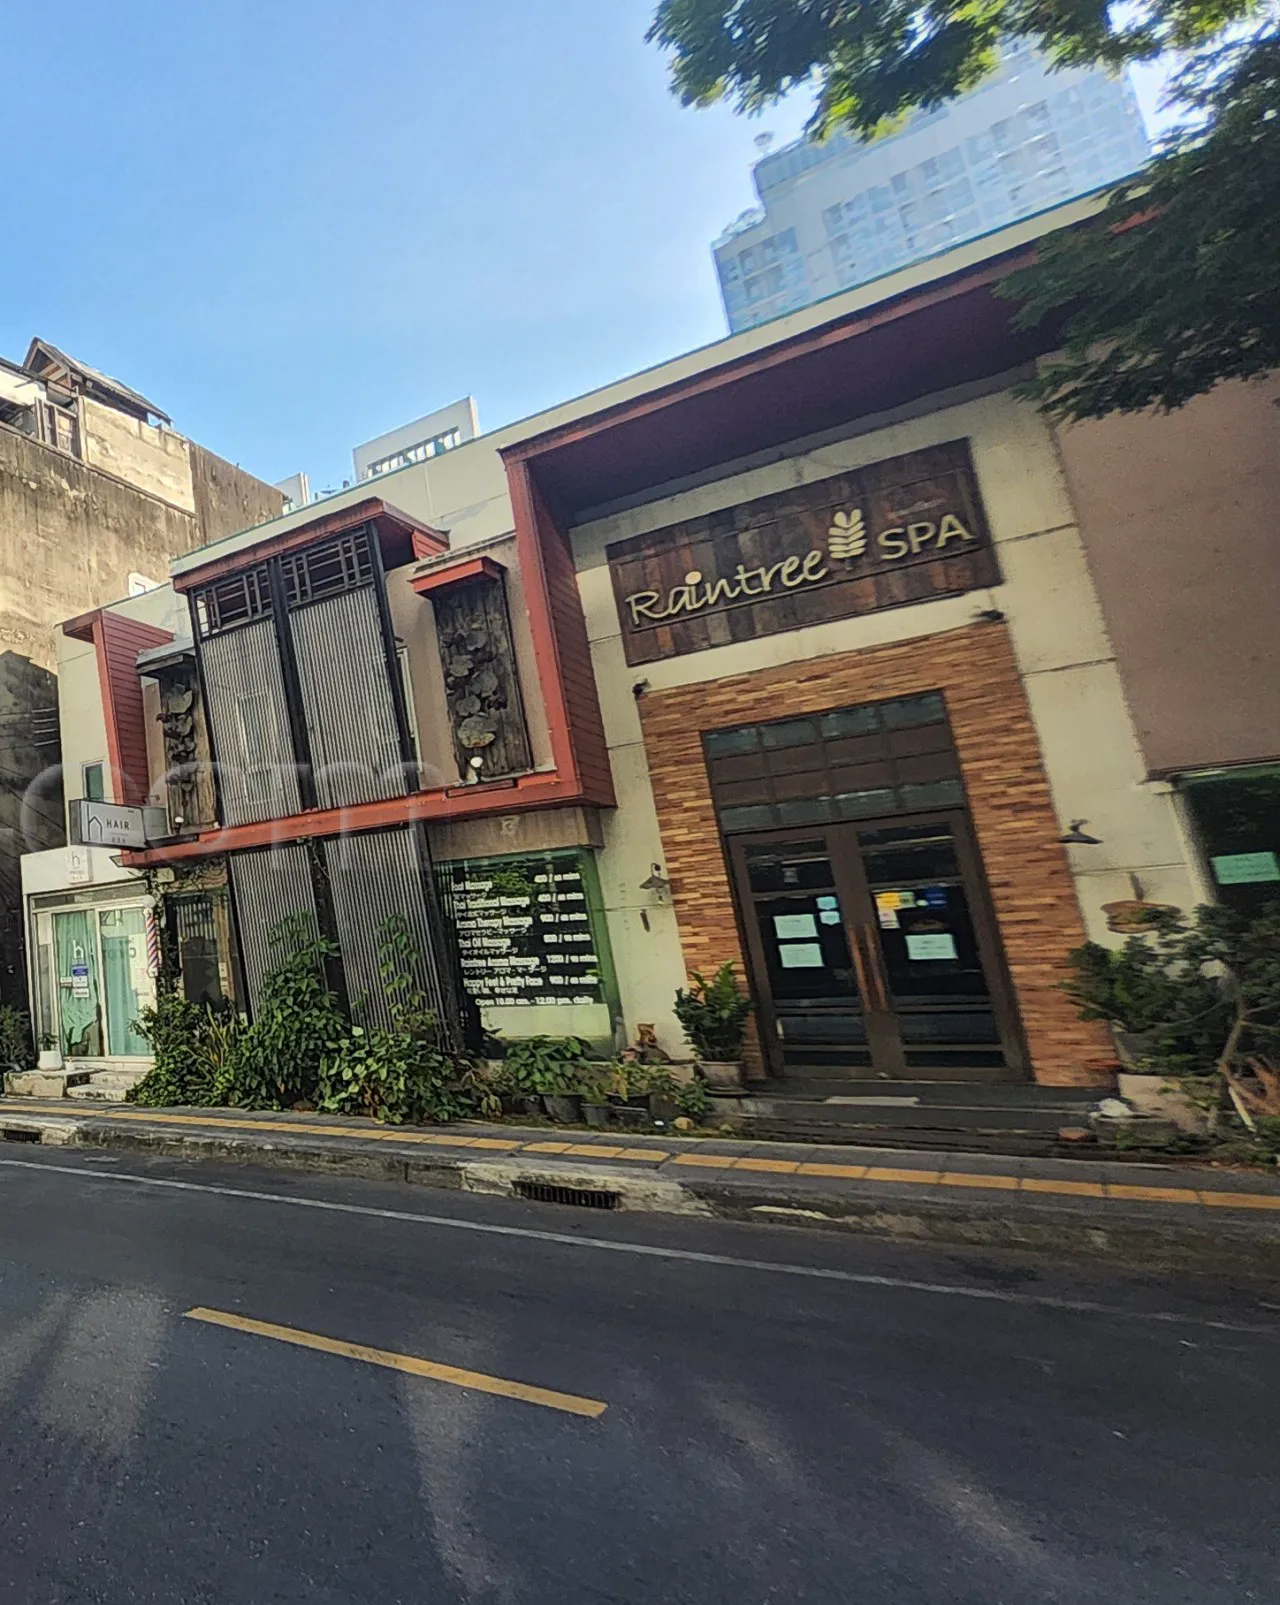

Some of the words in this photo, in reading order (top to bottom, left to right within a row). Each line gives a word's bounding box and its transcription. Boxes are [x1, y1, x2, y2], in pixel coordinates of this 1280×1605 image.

[625, 548, 828, 624] Raintree
[876, 513, 974, 562] SPA
[106, 819, 130, 830] HAIR
